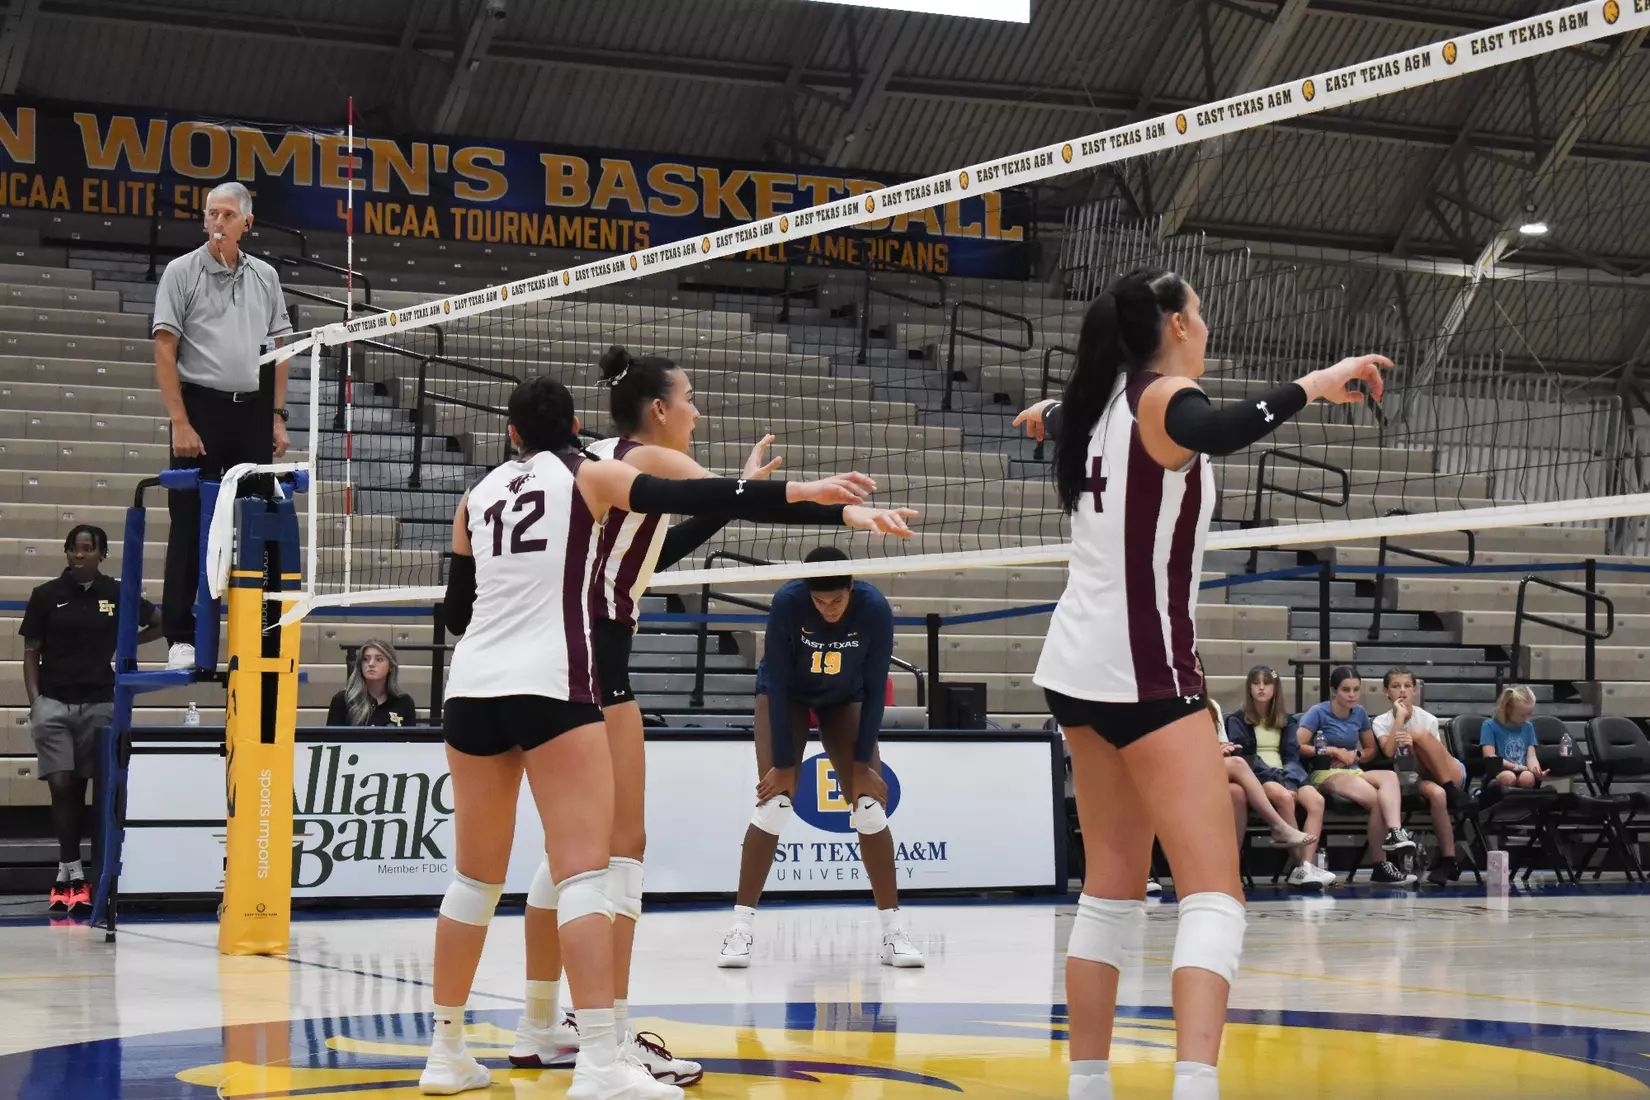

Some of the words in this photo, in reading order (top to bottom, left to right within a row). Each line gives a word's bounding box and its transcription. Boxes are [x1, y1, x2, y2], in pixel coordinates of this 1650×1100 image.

[1471, 33, 1504, 55] EAST
[1509, 20, 1553, 45] TEXAS
[1559, 11, 1588, 32] A&M
[1326, 72, 1356, 92] EAST
[1360, 61, 1400, 83] TEXAS
[1405, 52, 1431, 72] A&M
[1197, 108, 1224, 126] EAST
[1228, 98, 1264, 118] TEXAS
[1268, 89, 1292, 108] A&M
[1082, 139, 1106, 156] EAST
[1110, 130, 1141, 148] TEXAS
[1146, 122, 1165, 140] A&M
[74, 112, 508, 201] WOMEN'S
[977, 166, 999, 182] EAST
[1002, 157, 1031, 176] TEXAS
[1034, 152, 1053, 168] A&M
[0, 172, 70, 211] CAA
[882, 191, 902, 207] EAST
[905, 183, 931, 202] TEXAS
[934, 179, 952, 194] A&M
[364, 202, 441, 239] NCAA
[450, 206, 650, 251] TOURNAMENTS
[795, 212, 814, 227] EAST
[816, 206, 840, 222] TEXAS
[843, 202, 858, 216] A&M
[716, 233, 733, 248] EAST
[735, 228, 758, 242] TEXAS
[760, 222, 773, 236] A&M
[643, 253, 659, 265] EAST
[660, 247, 681, 261] TEXAS
[683, 243, 696, 256] A&M
[512, 284, 526, 295] EAST
[527, 279, 545, 292] TEXAS
[547, 276, 559, 287] A&M
[576, 269, 589, 281] EAST
[591, 264, 611, 277] TEXAS
[613, 261, 625, 272] A&M
[484, 490, 548, 556] 12
[801, 634, 824, 649] EAST
[828, 641, 859, 649] TEXAS
[810, 651, 842, 674] 19
[258, 768, 272, 817] sports
[293, 745, 455, 815] llianc
[256, 820, 270, 878] imports
[291, 818, 448, 888] Bank
[894, 842, 948, 861] A&M
[378, 864, 419, 874] Member
[422, 864, 448, 873] FDIC
[777, 868, 914, 881] UNIVERY
